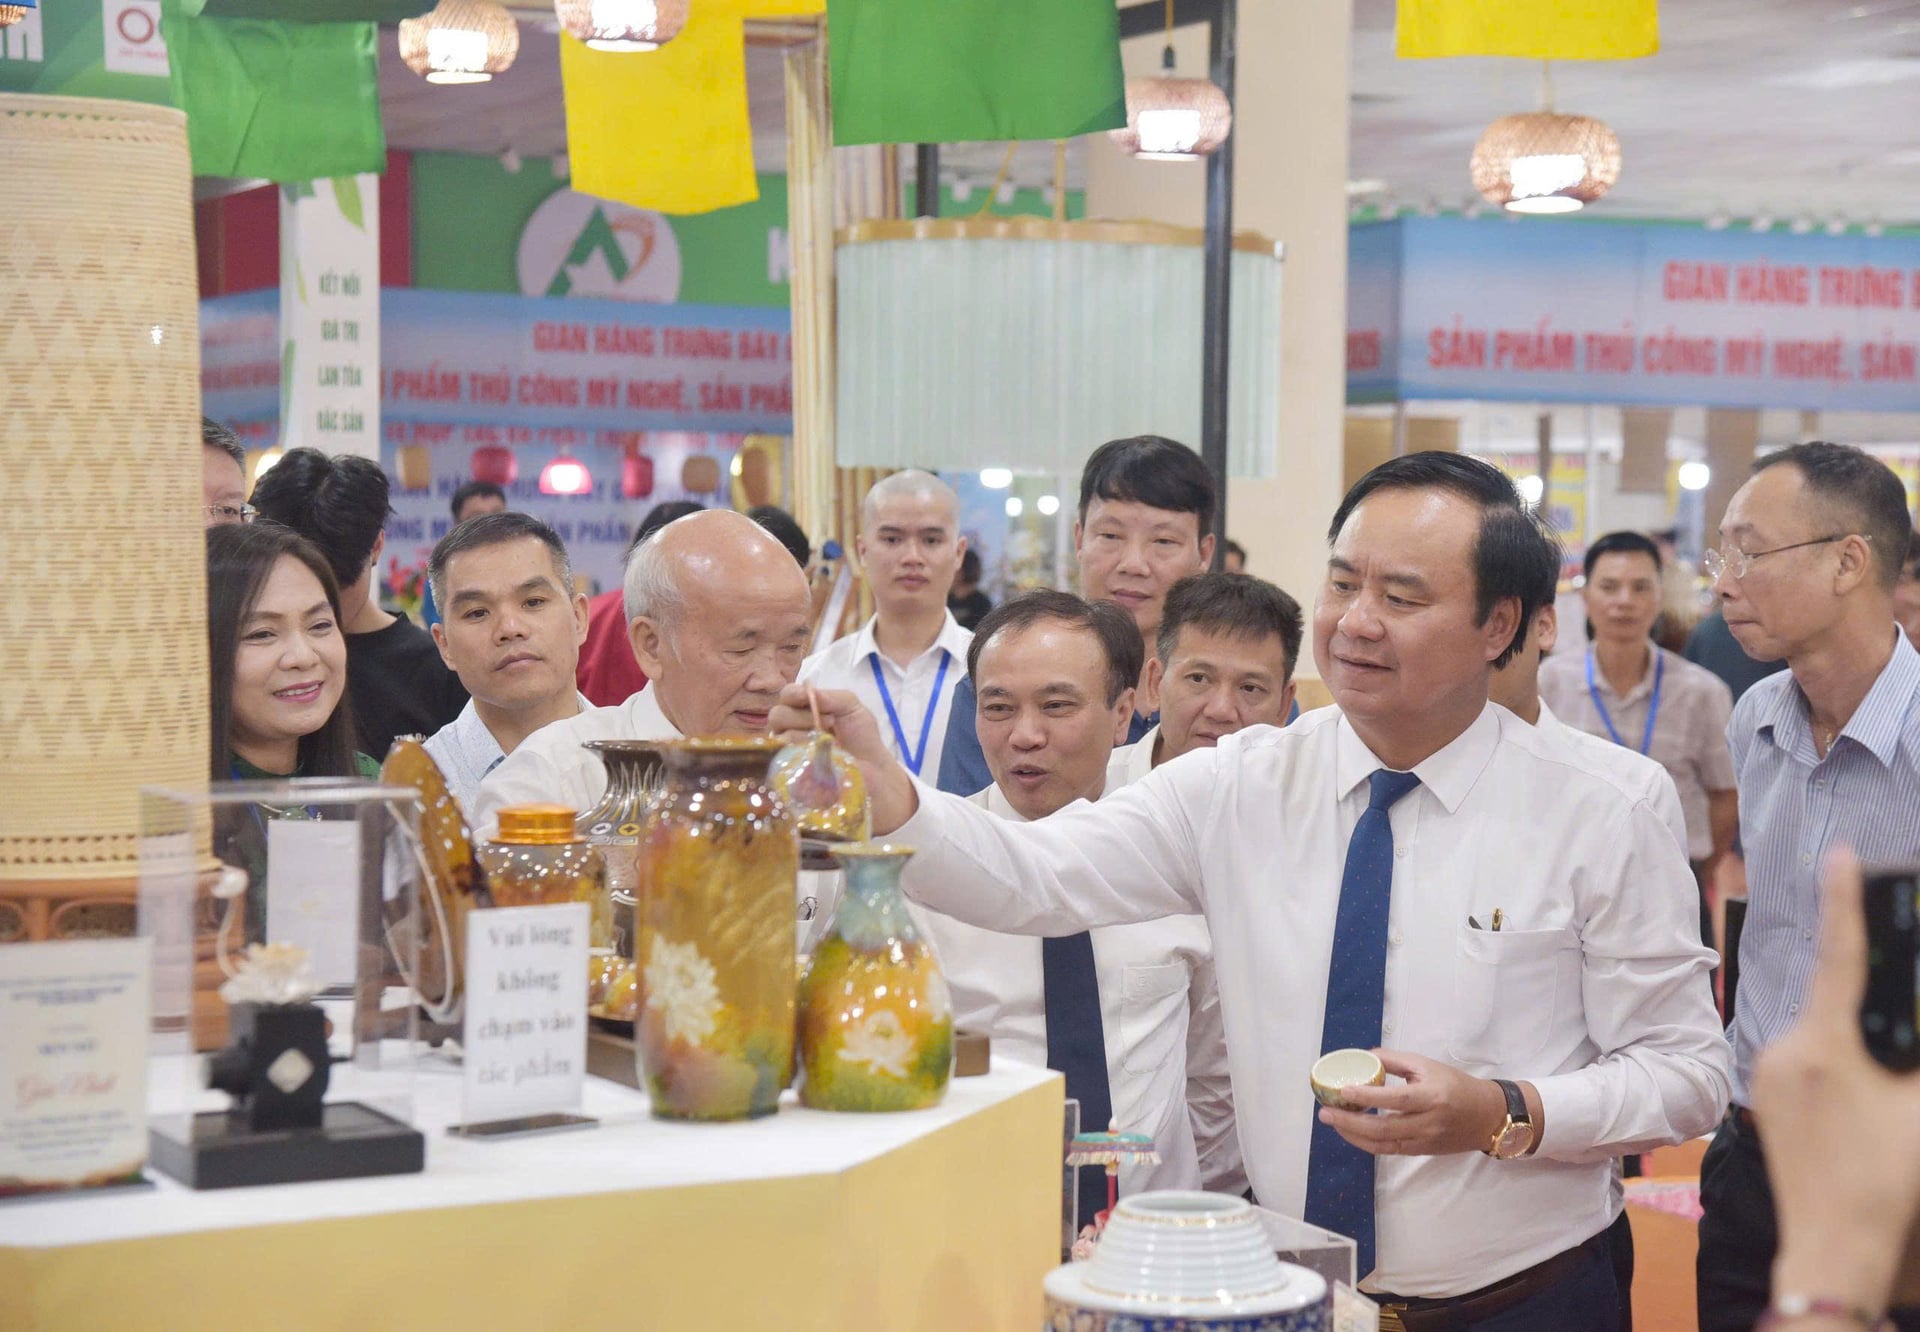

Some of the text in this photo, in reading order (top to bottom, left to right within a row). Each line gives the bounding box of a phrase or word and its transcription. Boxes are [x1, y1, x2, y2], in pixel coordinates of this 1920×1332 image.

[1663, 258, 1729, 303] GIAN
[1736, 252, 1809, 307] HÀNG
[532, 319, 588, 352] GIAN
[594, 317, 655, 358] HÀNG
[1429, 313, 1487, 371] SẢN
[1861, 327, 1915, 382] SẢN
